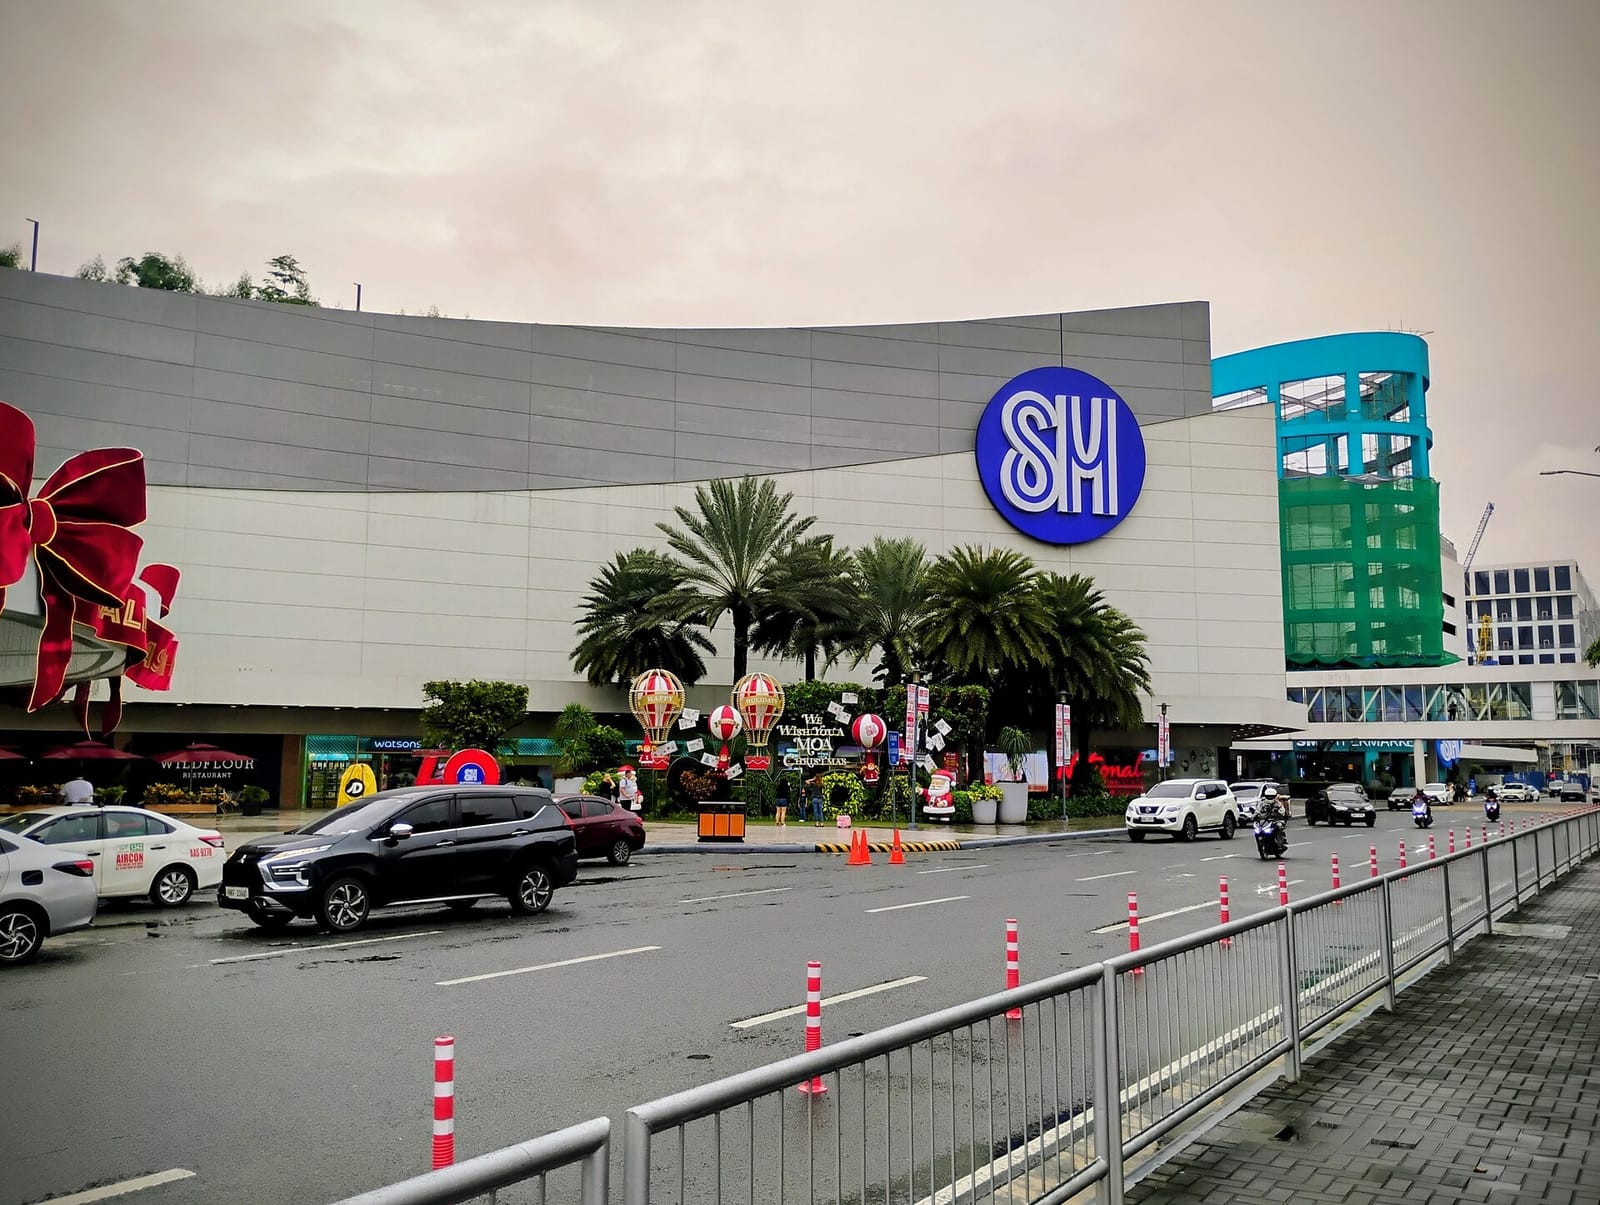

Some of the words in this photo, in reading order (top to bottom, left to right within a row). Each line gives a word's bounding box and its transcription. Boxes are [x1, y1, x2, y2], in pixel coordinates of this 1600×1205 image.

[1000, 390, 1118, 515] SM
[374, 740, 422, 749] watsons
[793, 737, 833, 756] MOA
[161, 760, 254, 769] WILDFLOUR
[346, 781, 364, 794] JD
[116, 853, 144, 865] AIRCON
